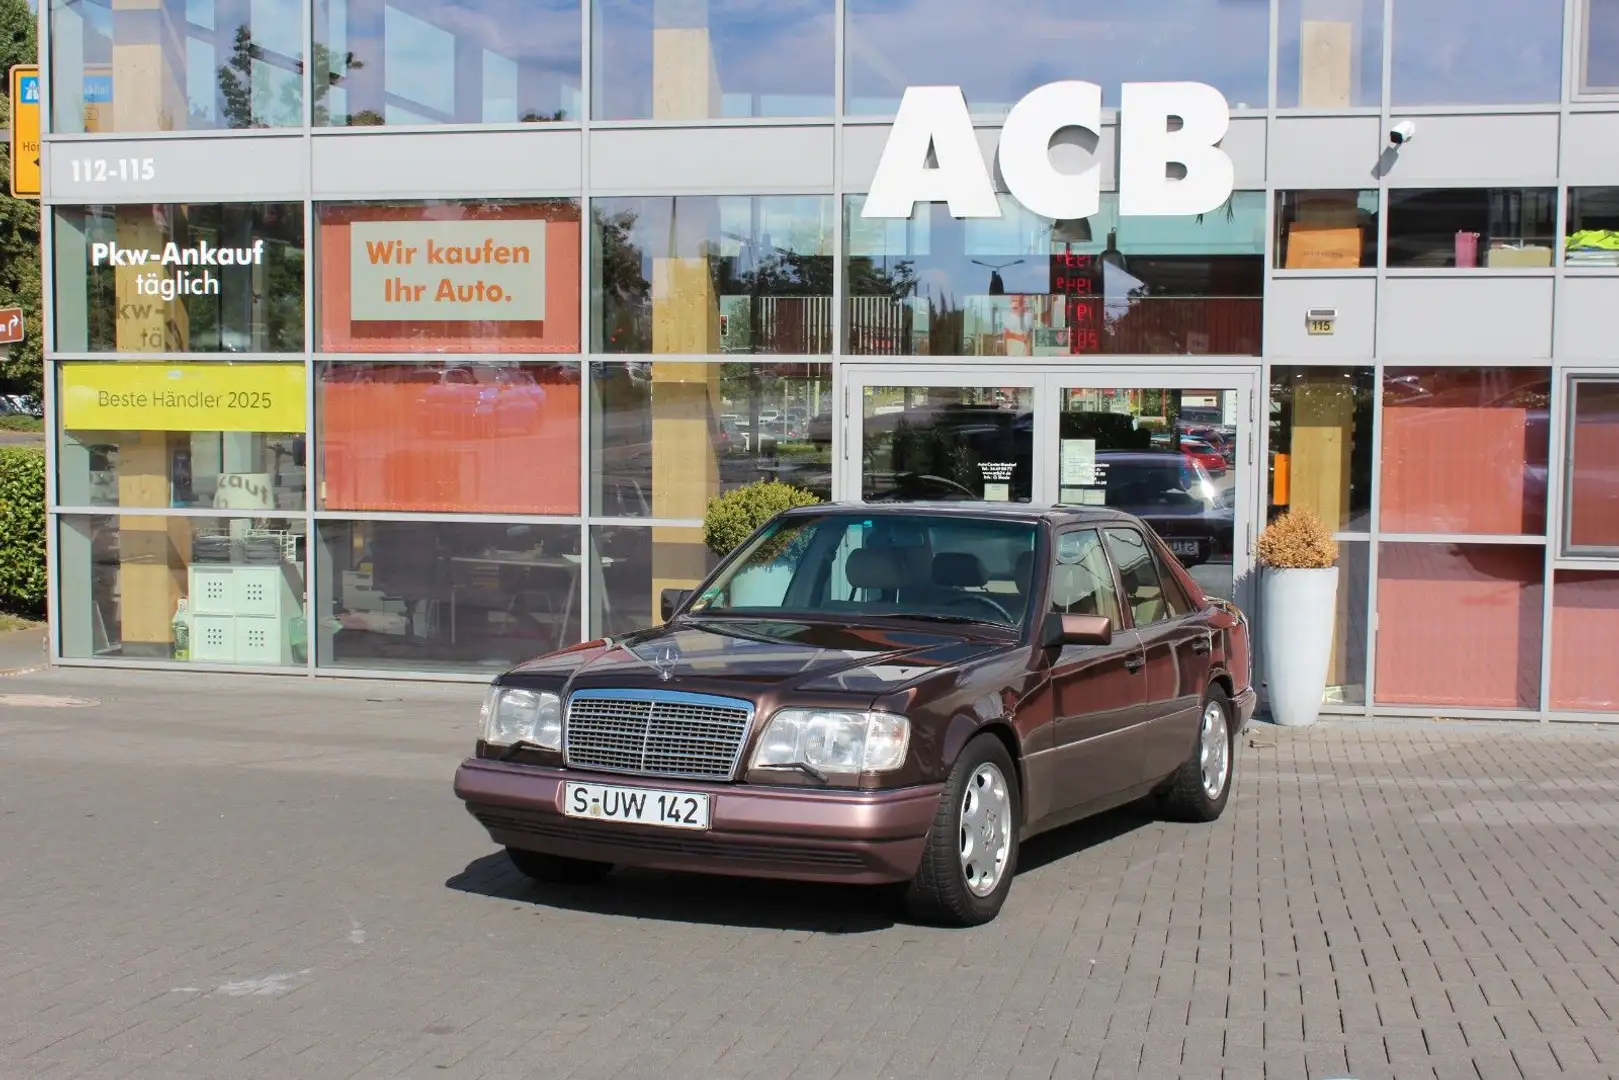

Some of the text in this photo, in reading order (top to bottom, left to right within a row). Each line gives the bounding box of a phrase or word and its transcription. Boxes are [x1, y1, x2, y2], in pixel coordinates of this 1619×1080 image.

[860, 80, 1235, 220] ACB
[71, 157, 156, 183] 112-115
[92, 240, 264, 267] Pkw-Ankauf
[366, 238, 531, 265] Wir kaufen
[135, 269, 220, 301] täglich
[384, 275, 513, 303] Ihr Auto.
[1312, 319, 1331, 331] 115
[98, 390, 273, 409] Beste Händler 2025
[573, 786, 699, 824] S-UW 142
